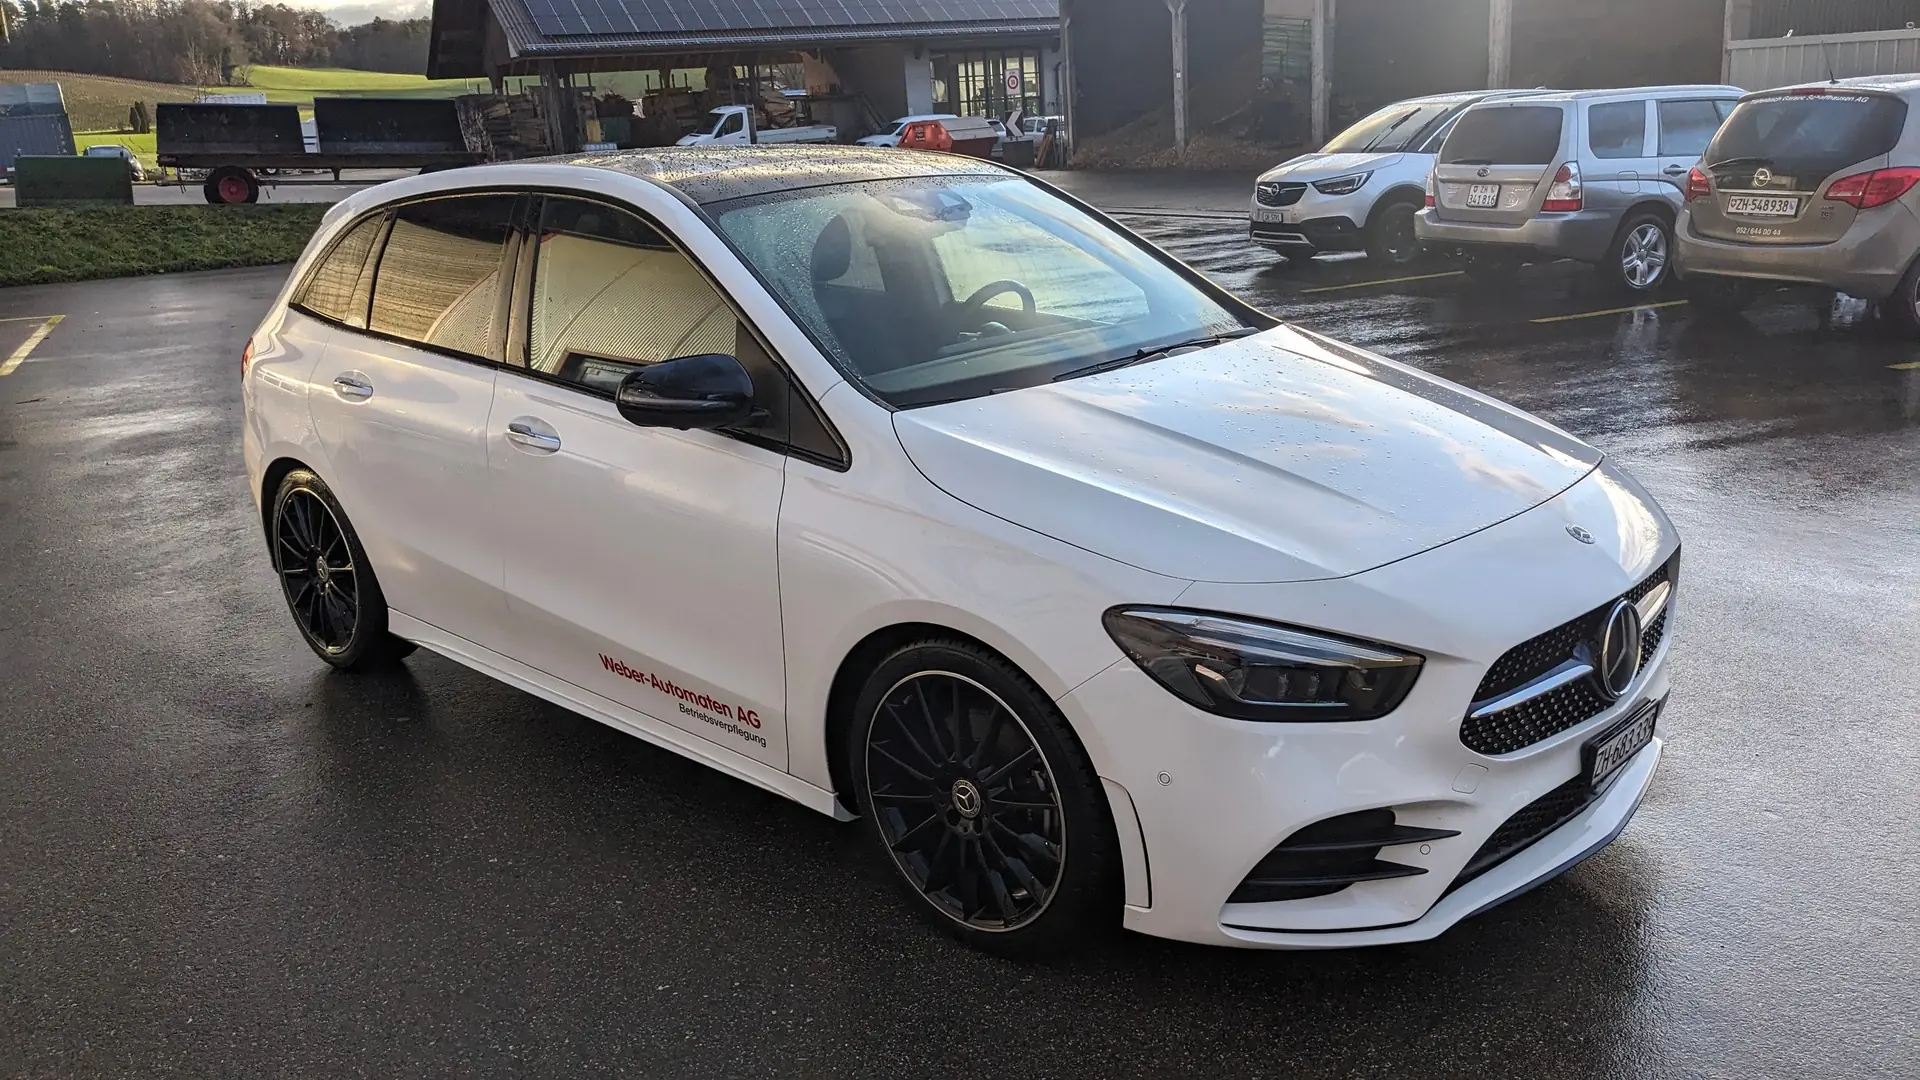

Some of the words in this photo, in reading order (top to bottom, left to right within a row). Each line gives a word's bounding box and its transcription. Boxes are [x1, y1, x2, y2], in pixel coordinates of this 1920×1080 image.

[598, 652, 733, 719] Weber-Automaten
[737, 705, 762, 730] AG
[678, 702, 767, 748] Betriebsverpflegung
